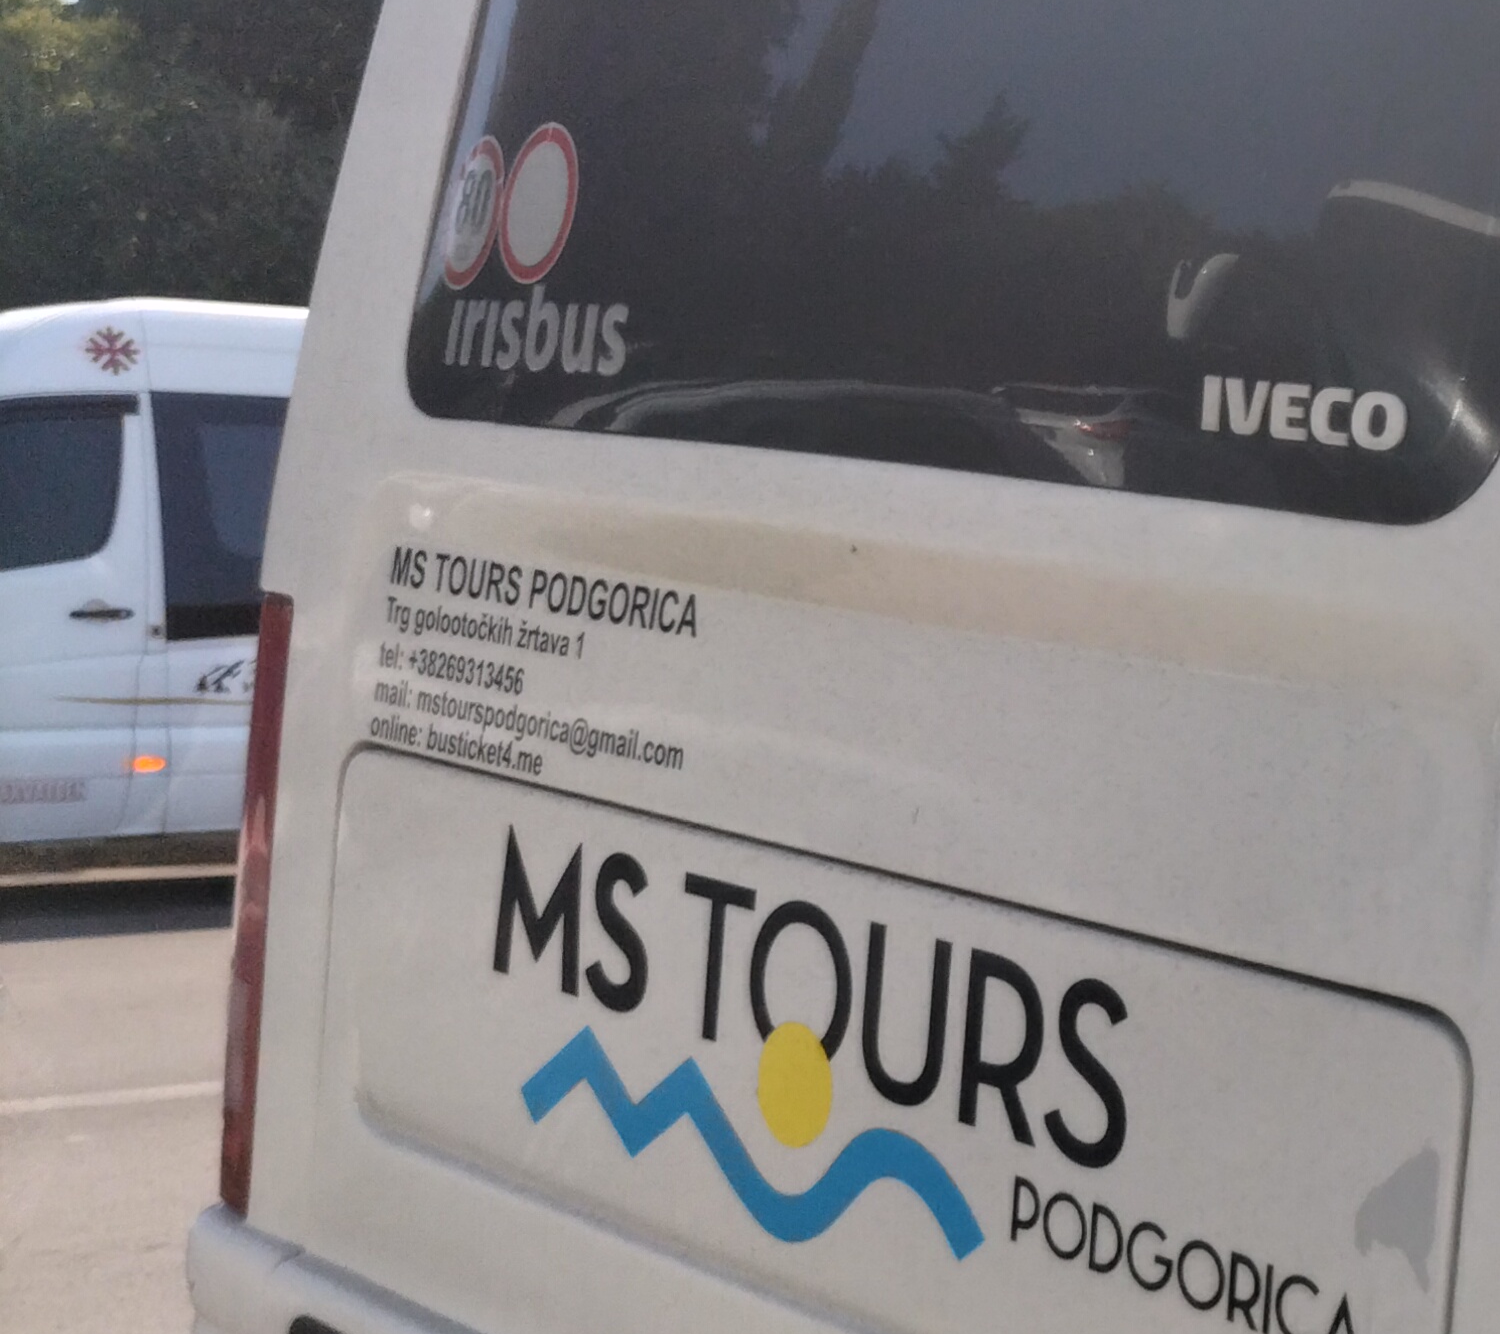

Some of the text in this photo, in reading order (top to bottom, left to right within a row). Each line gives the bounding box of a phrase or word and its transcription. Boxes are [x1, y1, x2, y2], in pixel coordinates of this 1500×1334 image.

[455, 168, 493, 235] 80
[1200, 375, 1409, 452] IVECO
[387, 596, 586, 659] Trg golootočkih žrtava 1
[390, 547, 698, 637] MS TOURS PODGORICA
[379, 641, 526, 696] tel: +38269313456
[370, 714, 544, 777] online: busticket4.me
[374, 679, 685, 771] mail: mstourspodgorica@gmail.com
[492, 824, 1130, 1170] MS TOURS
